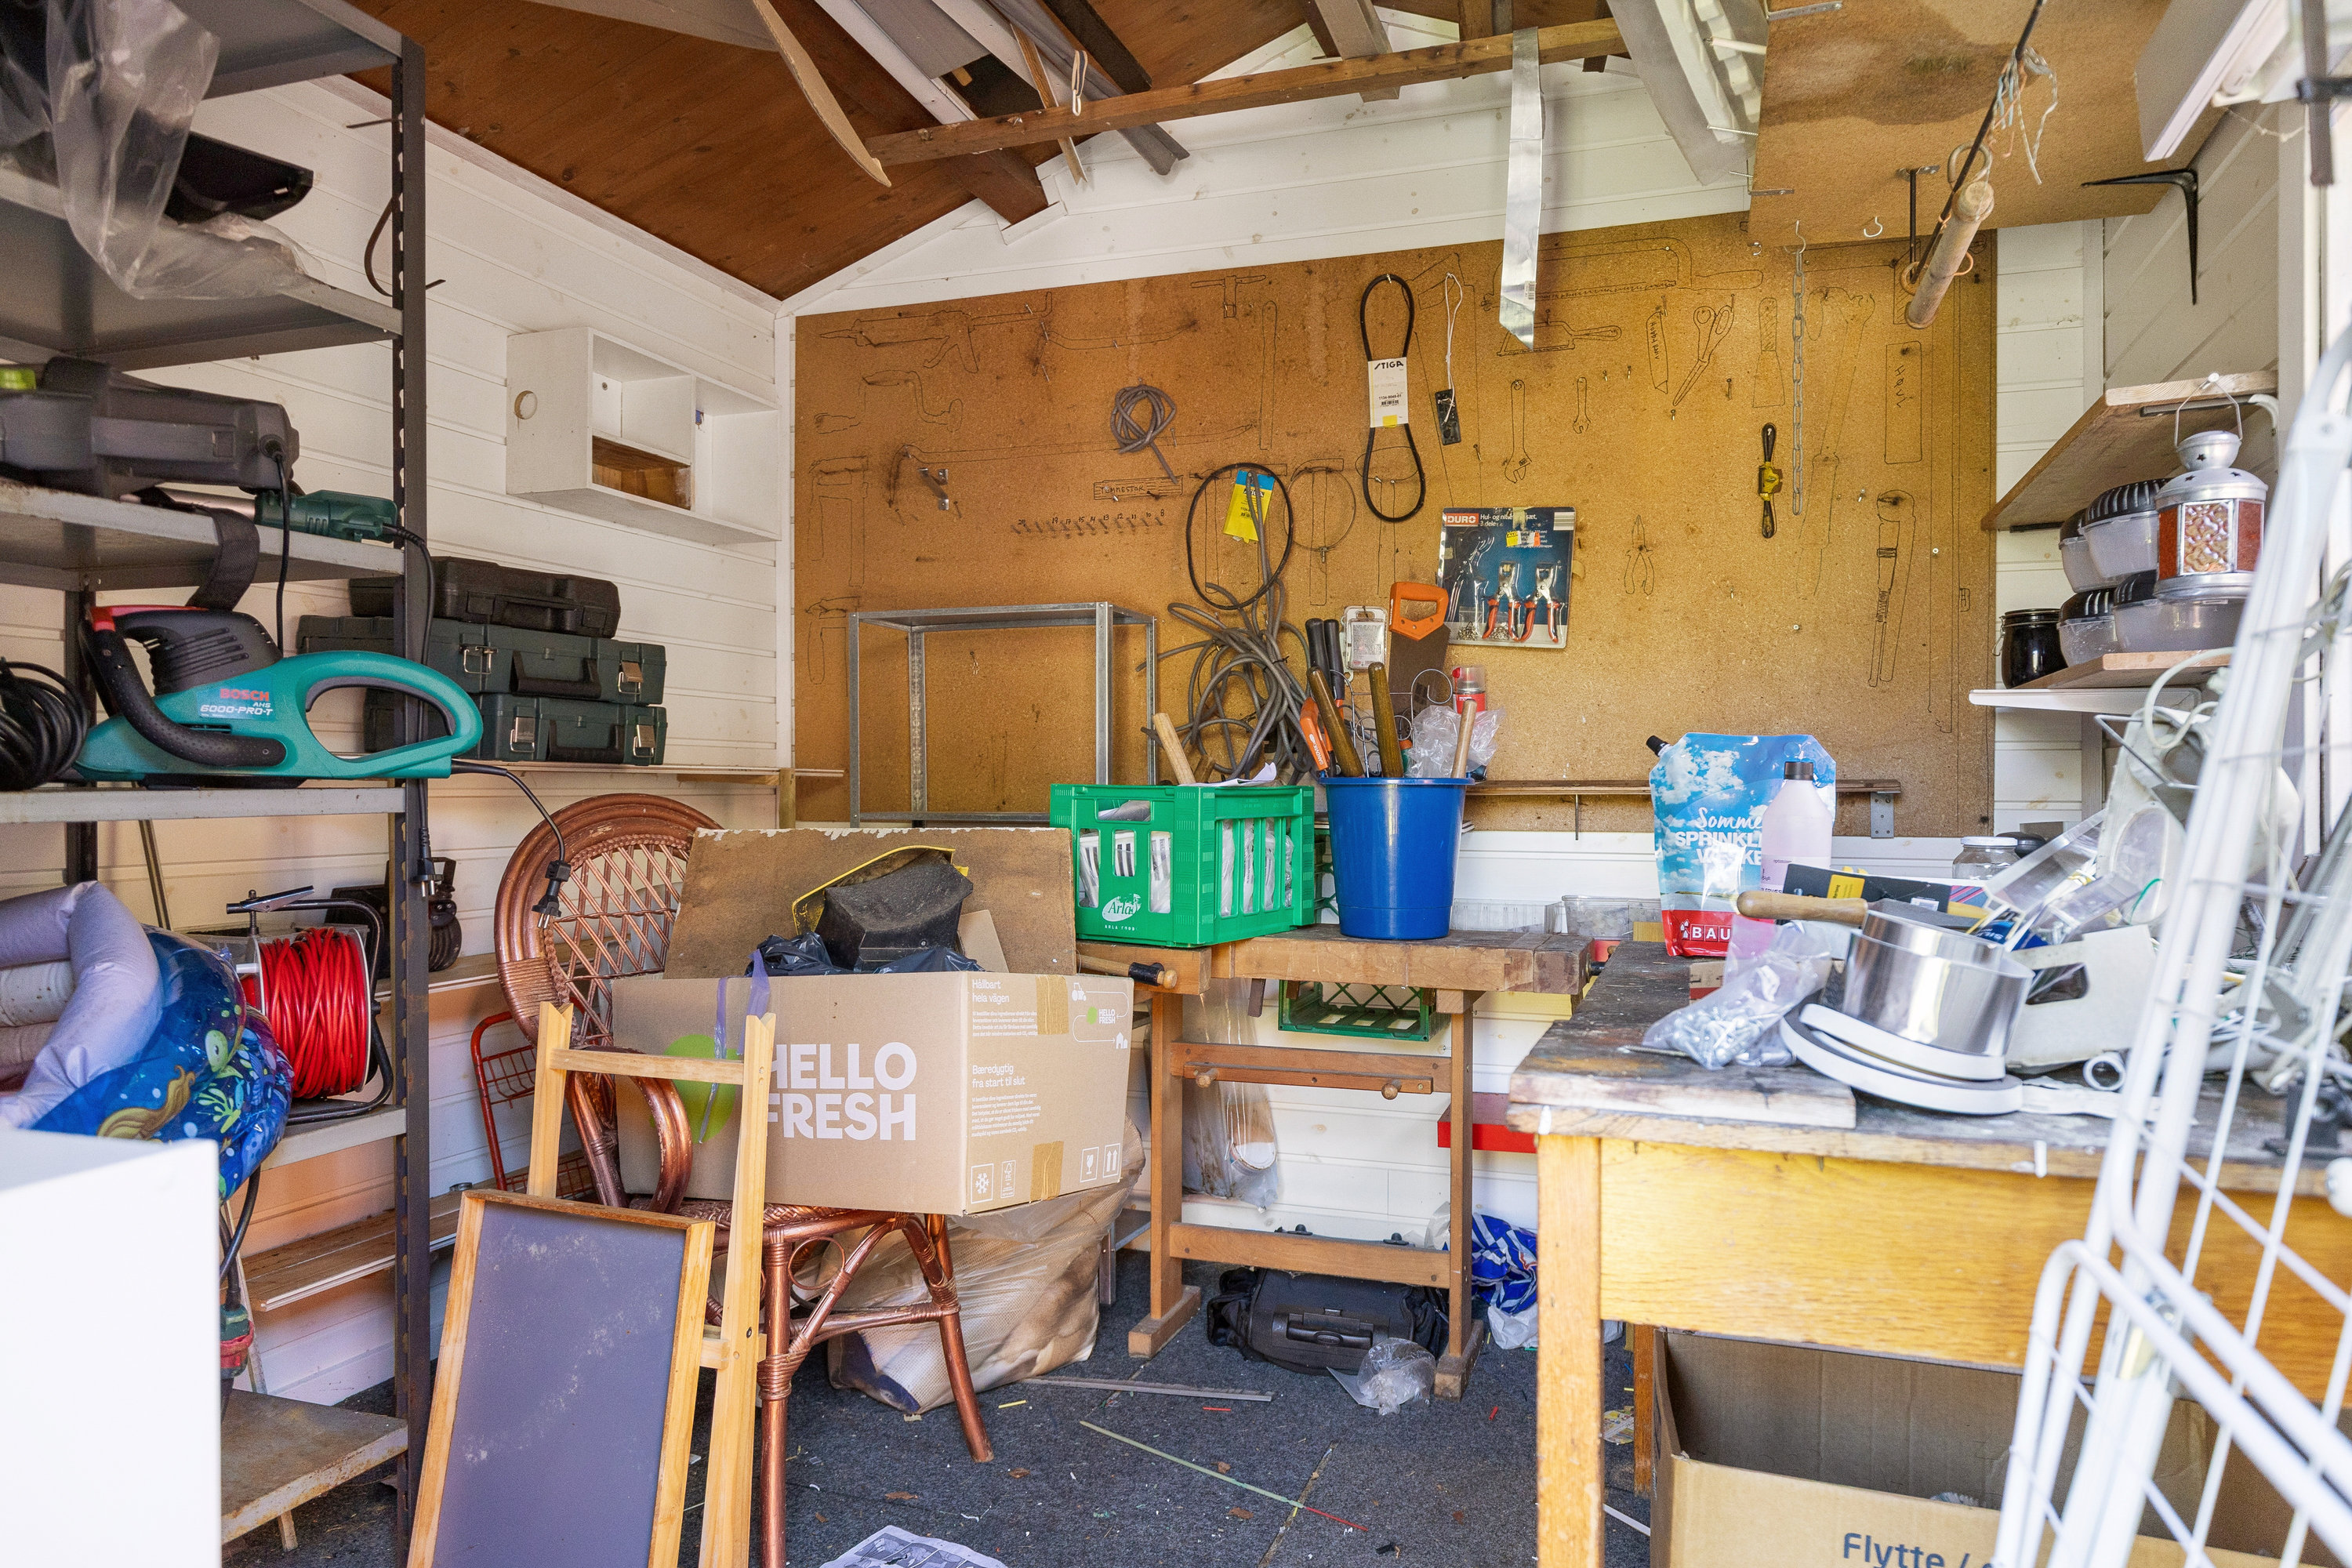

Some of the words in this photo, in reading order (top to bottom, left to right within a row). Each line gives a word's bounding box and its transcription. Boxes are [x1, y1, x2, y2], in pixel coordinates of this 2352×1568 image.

[1374, 361, 1403, 370] STIGA
[1447, 515, 1476, 524] DURO
[220, 688, 270, 701] BOSCH
[201, 704, 273, 716] 6000-PRO-T
[1108, 901, 1134, 915] Arla
[1692, 927, 1731, 940] BAU
[972, 978, 1001, 989] Hållbart
[972, 993, 987, 1003] hela
[989, 993, 1010, 1005] vägen
[1098, 1008, 1116, 1017] HELLO
[1098, 1016, 1116, 1025] FRESH
[972, 1063, 1014, 1076] Bæredygtig
[972, 1078, 984, 1088] fra
[985, 1076, 1004, 1087] start
[1013, 1076, 1026, 1085] slut
[1843, 1533, 1945, 1568] Flytte
